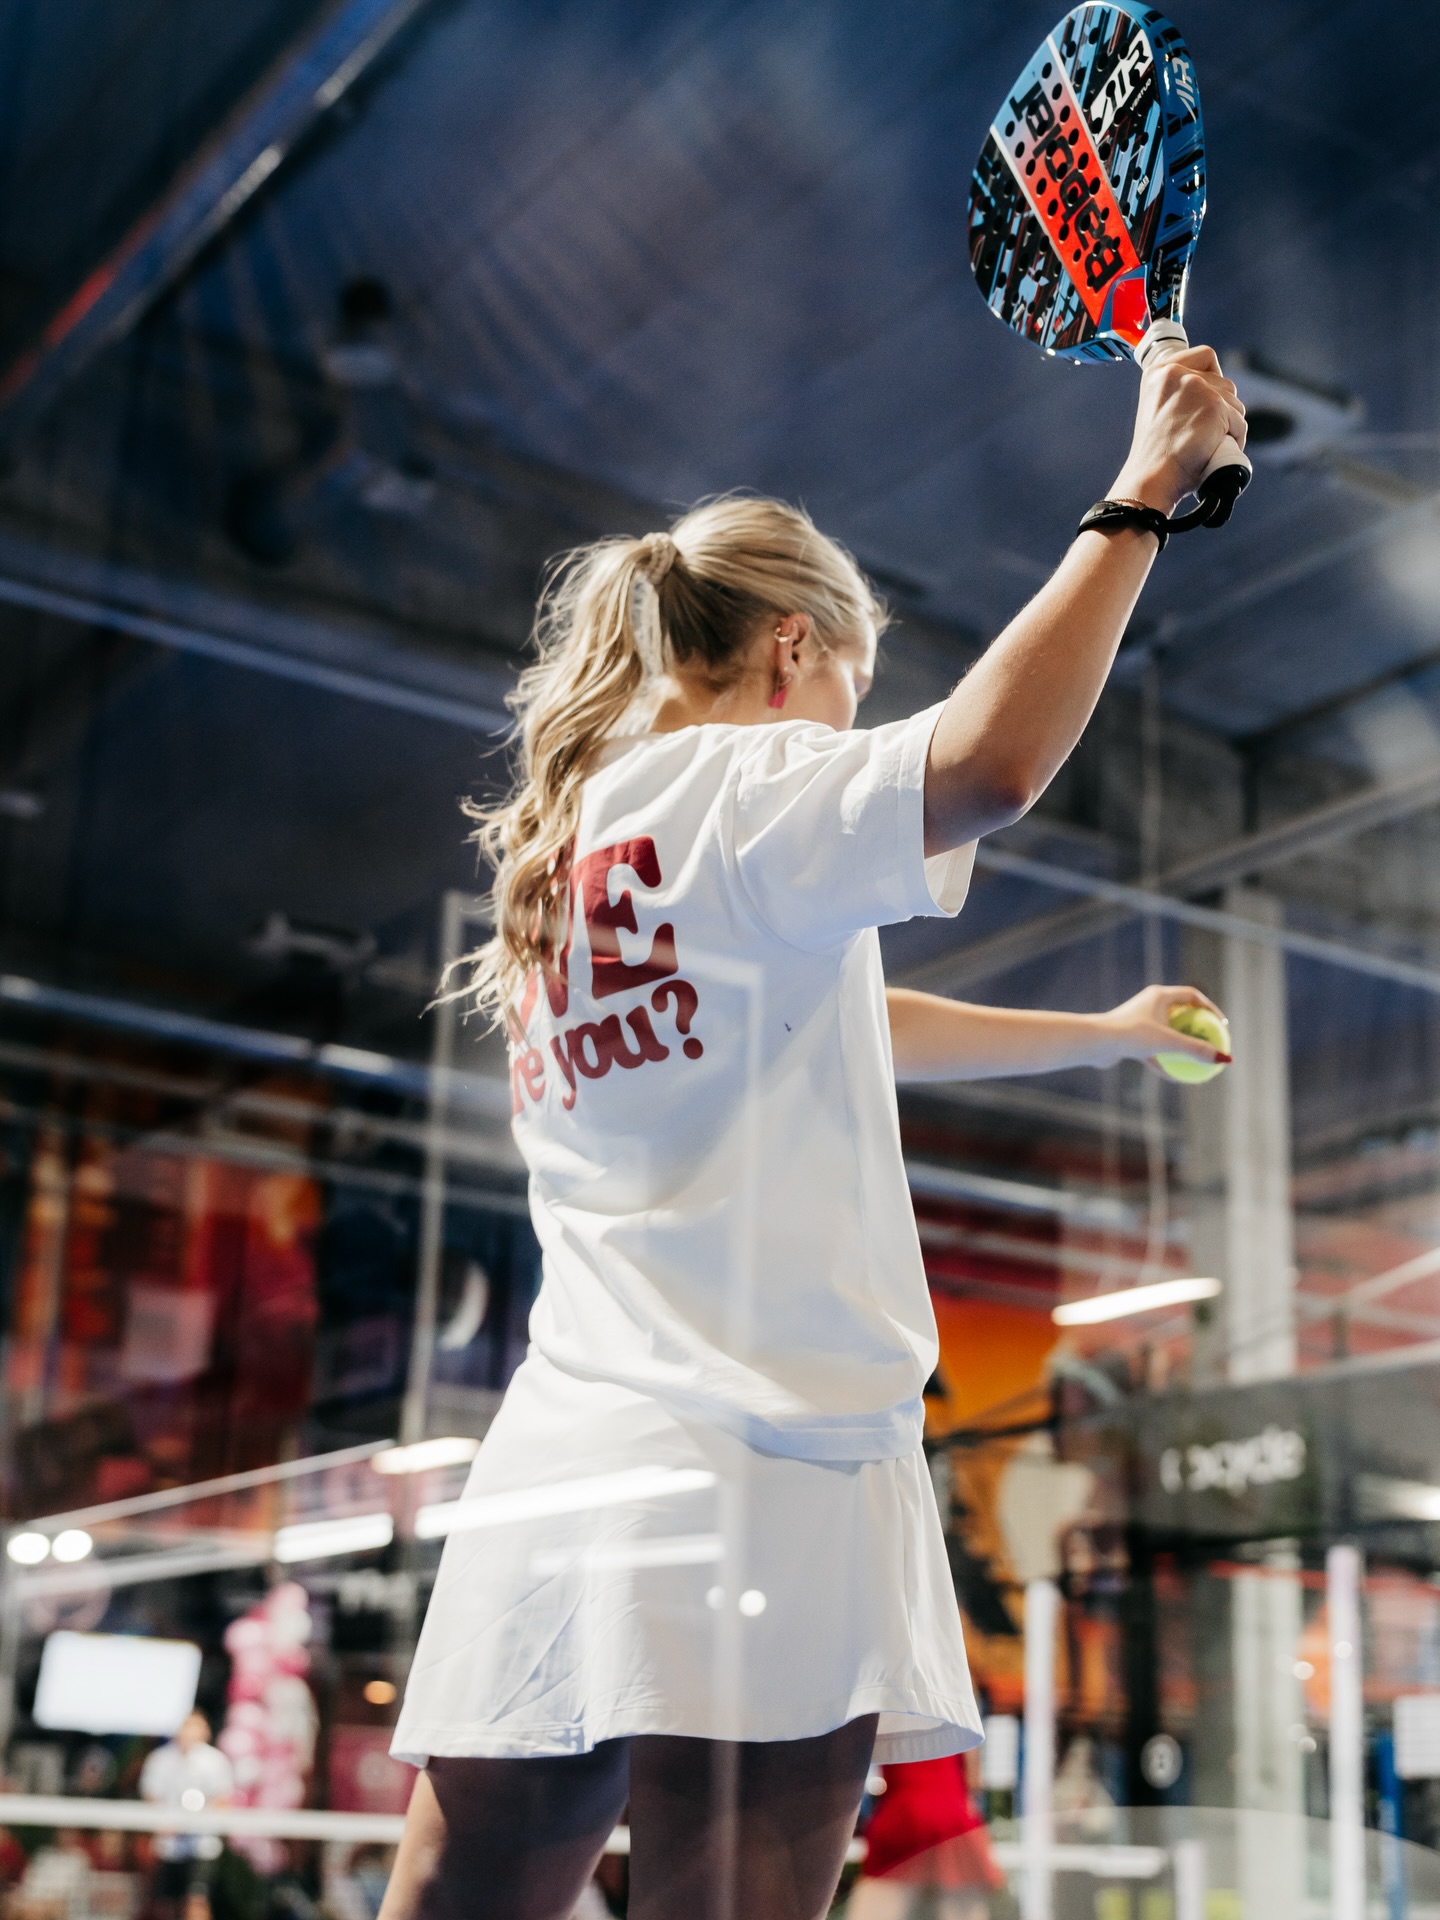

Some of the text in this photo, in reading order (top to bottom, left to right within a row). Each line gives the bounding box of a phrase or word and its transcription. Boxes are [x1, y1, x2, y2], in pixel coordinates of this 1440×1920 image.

[1130, 78, 1152, 111] VERTUO
[1172, 56, 1197, 123] AIR
[512, 979, 704, 1116] re you?
